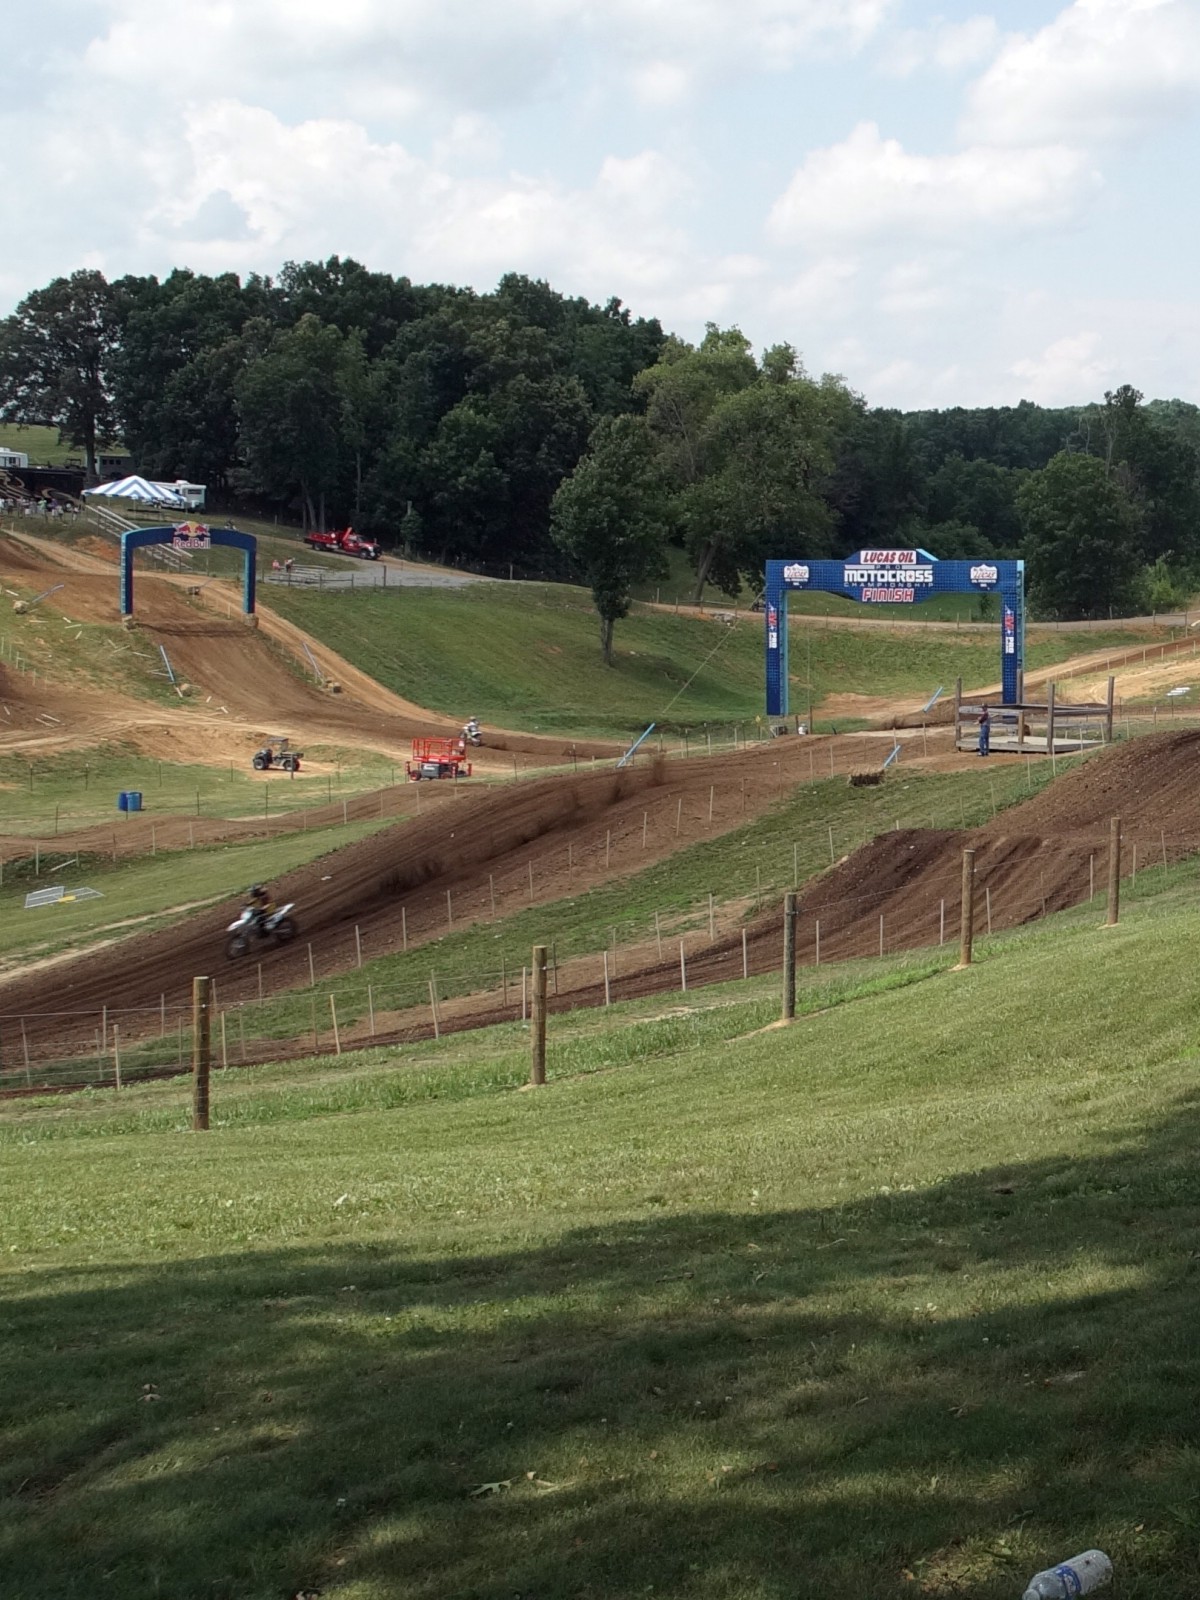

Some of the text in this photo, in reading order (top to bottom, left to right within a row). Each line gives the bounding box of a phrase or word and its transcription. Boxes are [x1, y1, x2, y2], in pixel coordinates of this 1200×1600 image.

[173, 537, 210, 548] Red Bull
[863, 551, 914, 564] LUCAS OIL
[844, 570, 933, 582] MOTOCROSS
[862, 588, 915, 603] FINISH
